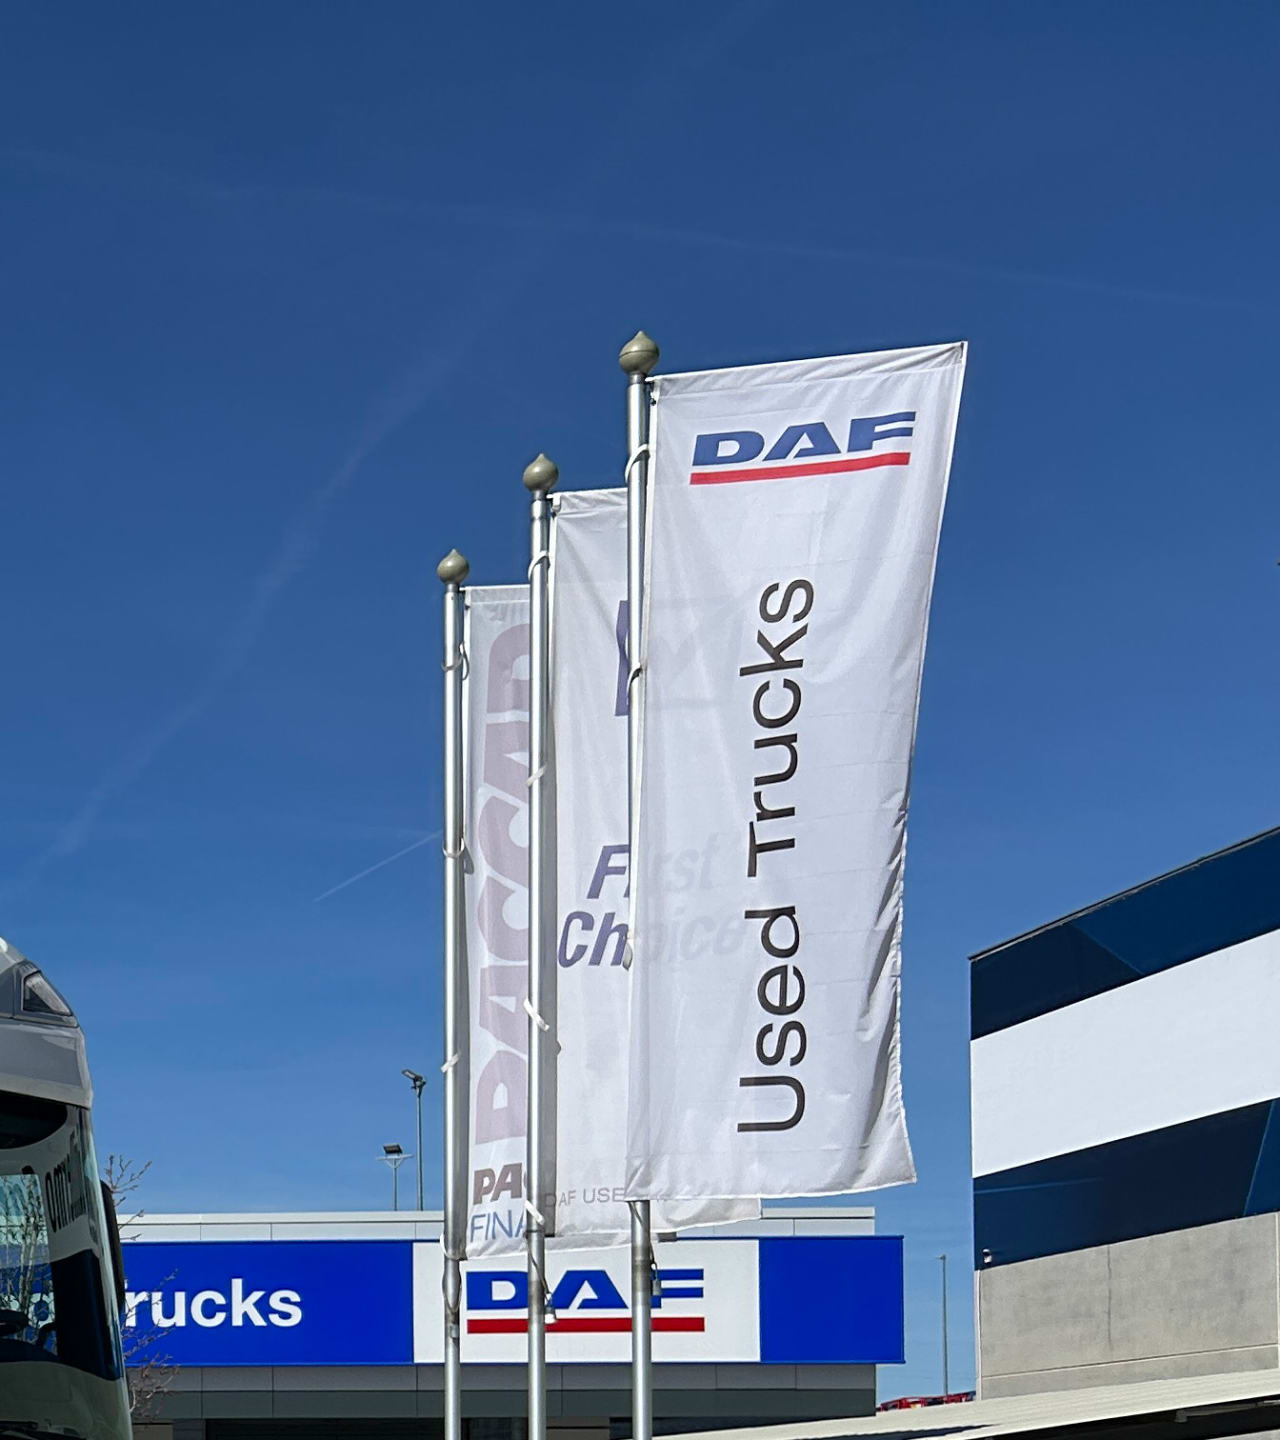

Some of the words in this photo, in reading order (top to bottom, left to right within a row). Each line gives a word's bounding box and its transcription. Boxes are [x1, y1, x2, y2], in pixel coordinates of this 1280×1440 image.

[693, 411, 916, 466] DAF
[739, 578, 814, 877] Trucks
[737, 905, 807, 1133] Used
[124, 1278, 302, 1328] rucks
[466, 1269, 704, 1310] DAF
